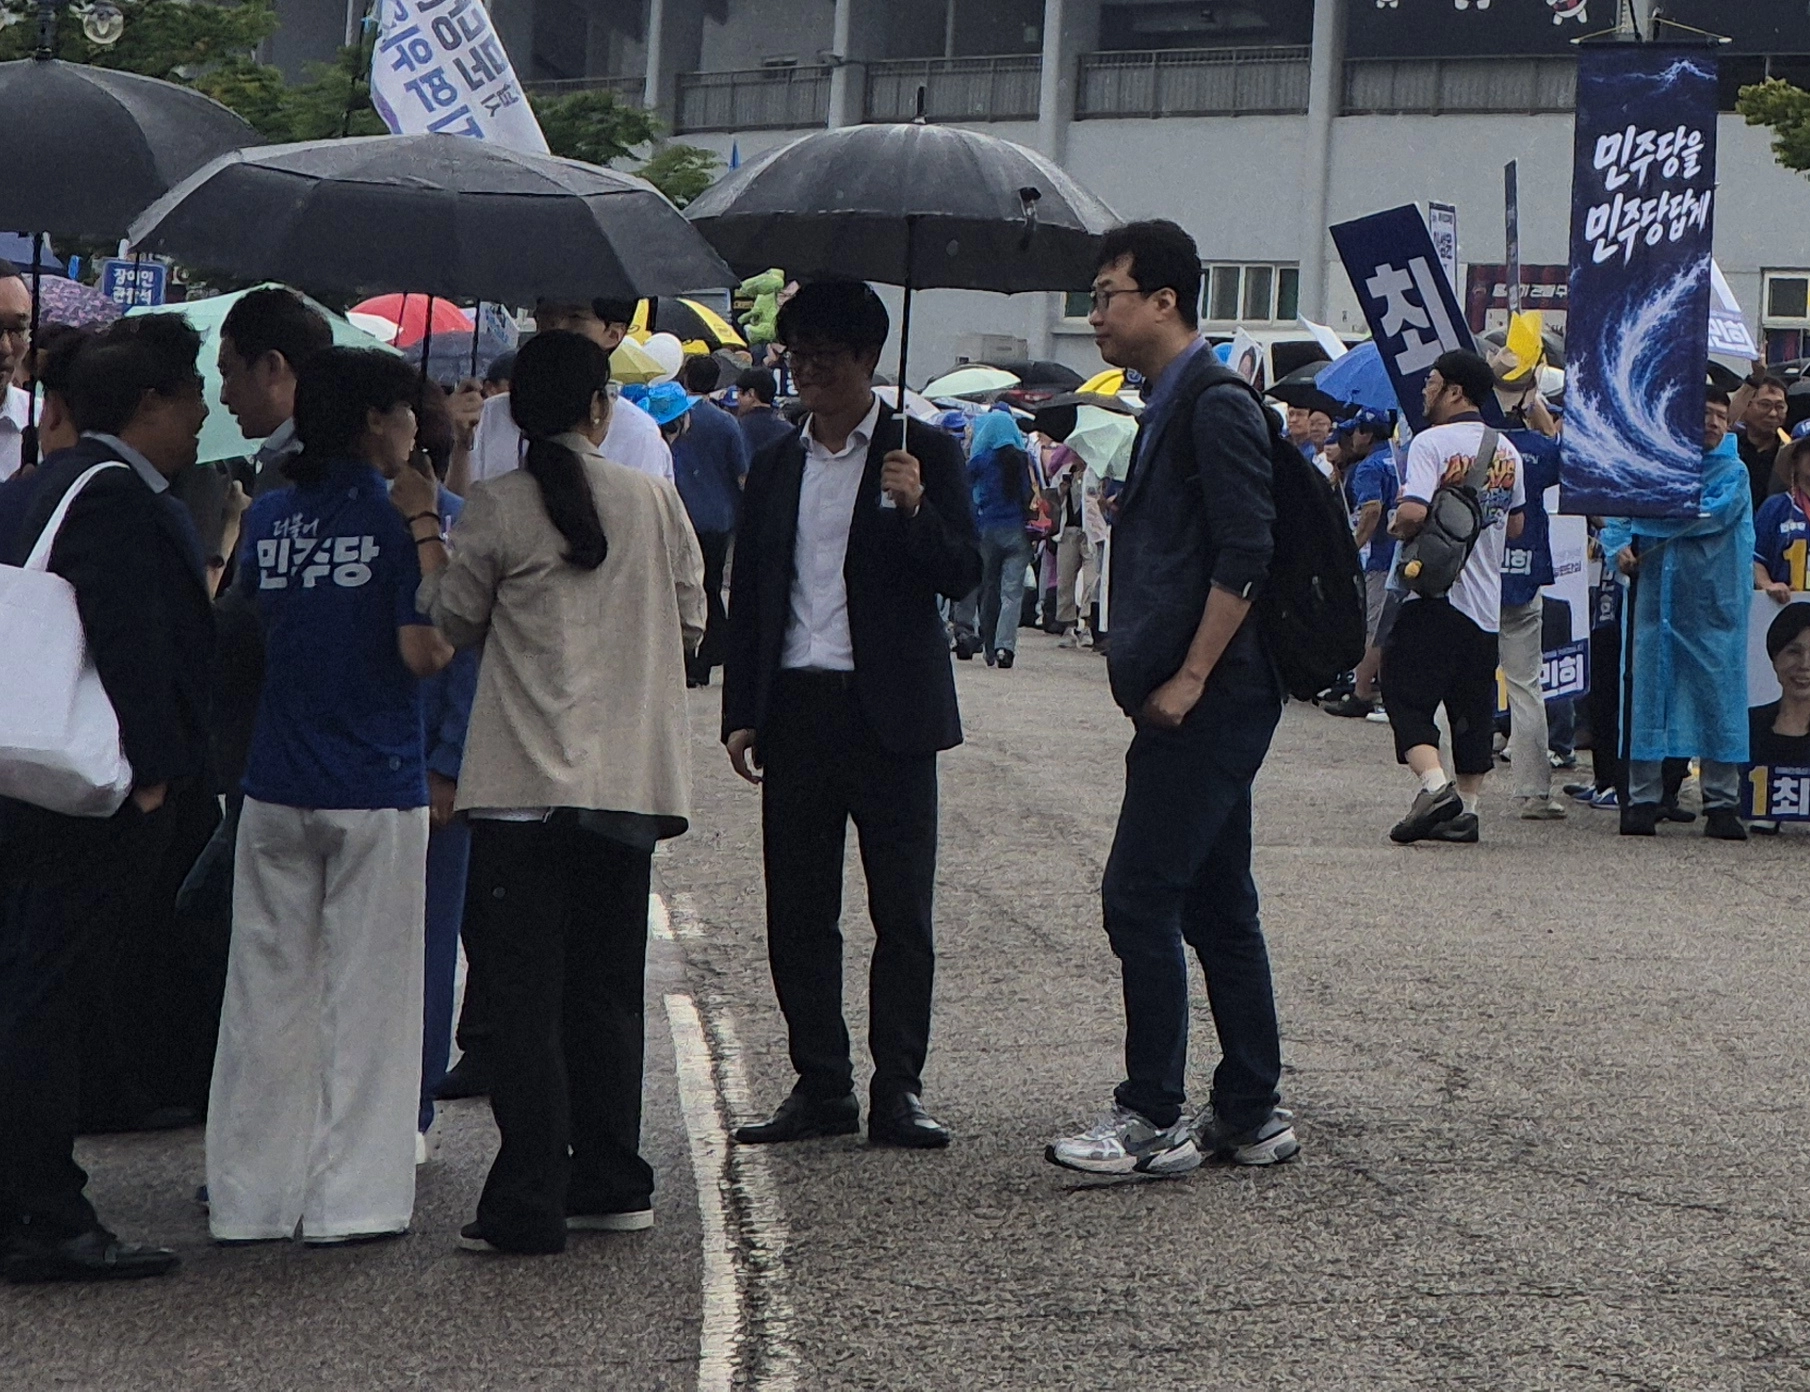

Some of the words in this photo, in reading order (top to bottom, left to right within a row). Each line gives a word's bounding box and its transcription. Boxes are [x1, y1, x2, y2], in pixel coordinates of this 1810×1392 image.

[1593, 124, 1704, 192] 민주당을
[1584, 187, 1712, 268] 민주당답게
[273, 512, 320, 538] 더불어
[257, 535, 380, 589] 민주당
